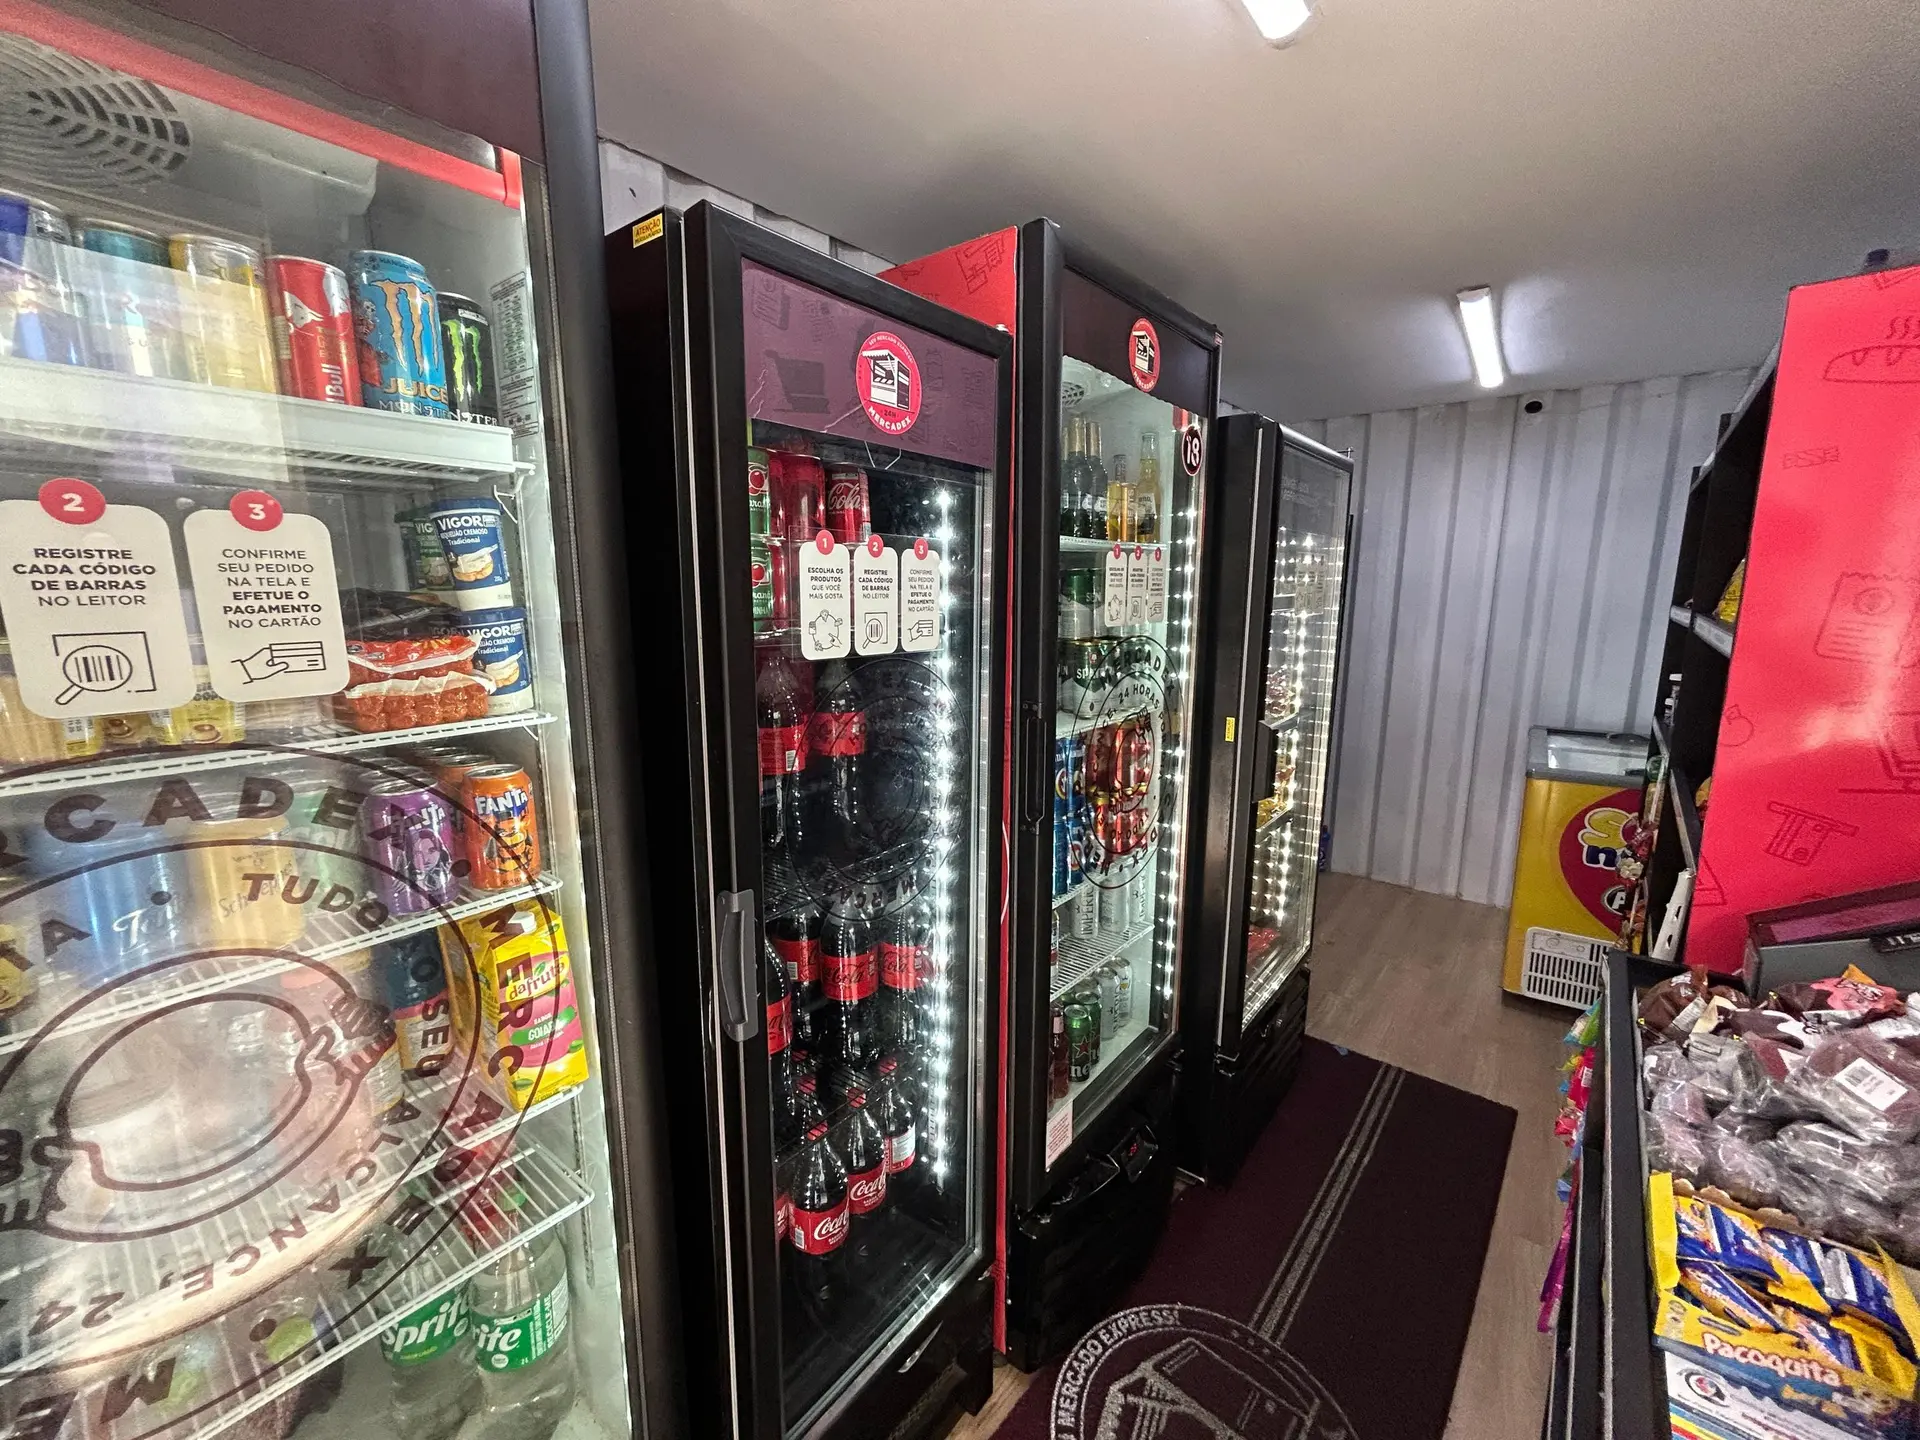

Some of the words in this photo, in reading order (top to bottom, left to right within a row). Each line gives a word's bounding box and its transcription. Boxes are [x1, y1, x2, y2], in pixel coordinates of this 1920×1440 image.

[320, 363, 344, 397] Bull
[383, 378, 448, 404] JUICE
[449, 409, 498, 427] NSTER
[868, 406, 912, 430] MERCADEX
[61, 493, 84, 512] 2
[1127, 489, 1135, 525] BETS
[248, 502, 266, 520] 3
[416, 522, 435, 534] VIG
[438, 516, 484, 531] VIGOR
[464, 528, 488, 536] CREMOSO
[448, 536, 480, 546] Tradicional
[822, 538, 828, 548] 1
[872, 543, 878, 552] 2
[918, 546, 924, 554] 3
[34, 548, 132, 560] REGISTRE
[222, 548, 306, 560] CONFIRME
[13, 563, 75, 575] CADA
[80, 561, 156, 576] CÓDIGO
[218, 562, 250, 573] SEU
[255, 563, 314, 574] PEDIDO
[32, 580, 61, 590] DE
[65, 580, 146, 590] BARRAS
[227, 576, 250, 587] NA
[256, 576, 296, 587] TELA
[302, 577, 310, 586] E
[828, 583, 841, 591] VOCÊ
[38, 595, 70, 606] NO
[77, 595, 146, 606] LEITOR
[233, 590, 293, 600] EFETUE
[298, 590, 310, 600] O
[223, 603, 322, 614] PAGAMENTO
[228, 618, 254, 628] NO
[258, 614, 322, 628] CARTÃO
[494, 636, 516, 645] CREMOSO
[1132, 684, 1160, 710] HORAS
[474, 788, 528, 816] FANTA
[241, 872, 390, 931] TUDO
[415, 1000, 450, 1078] SEU
[508, 962, 566, 1001] dafruta
[1057, 1338, 1103, 1428] MERCADO
[1098, 1310, 1180, 1346] EXPRESS!
